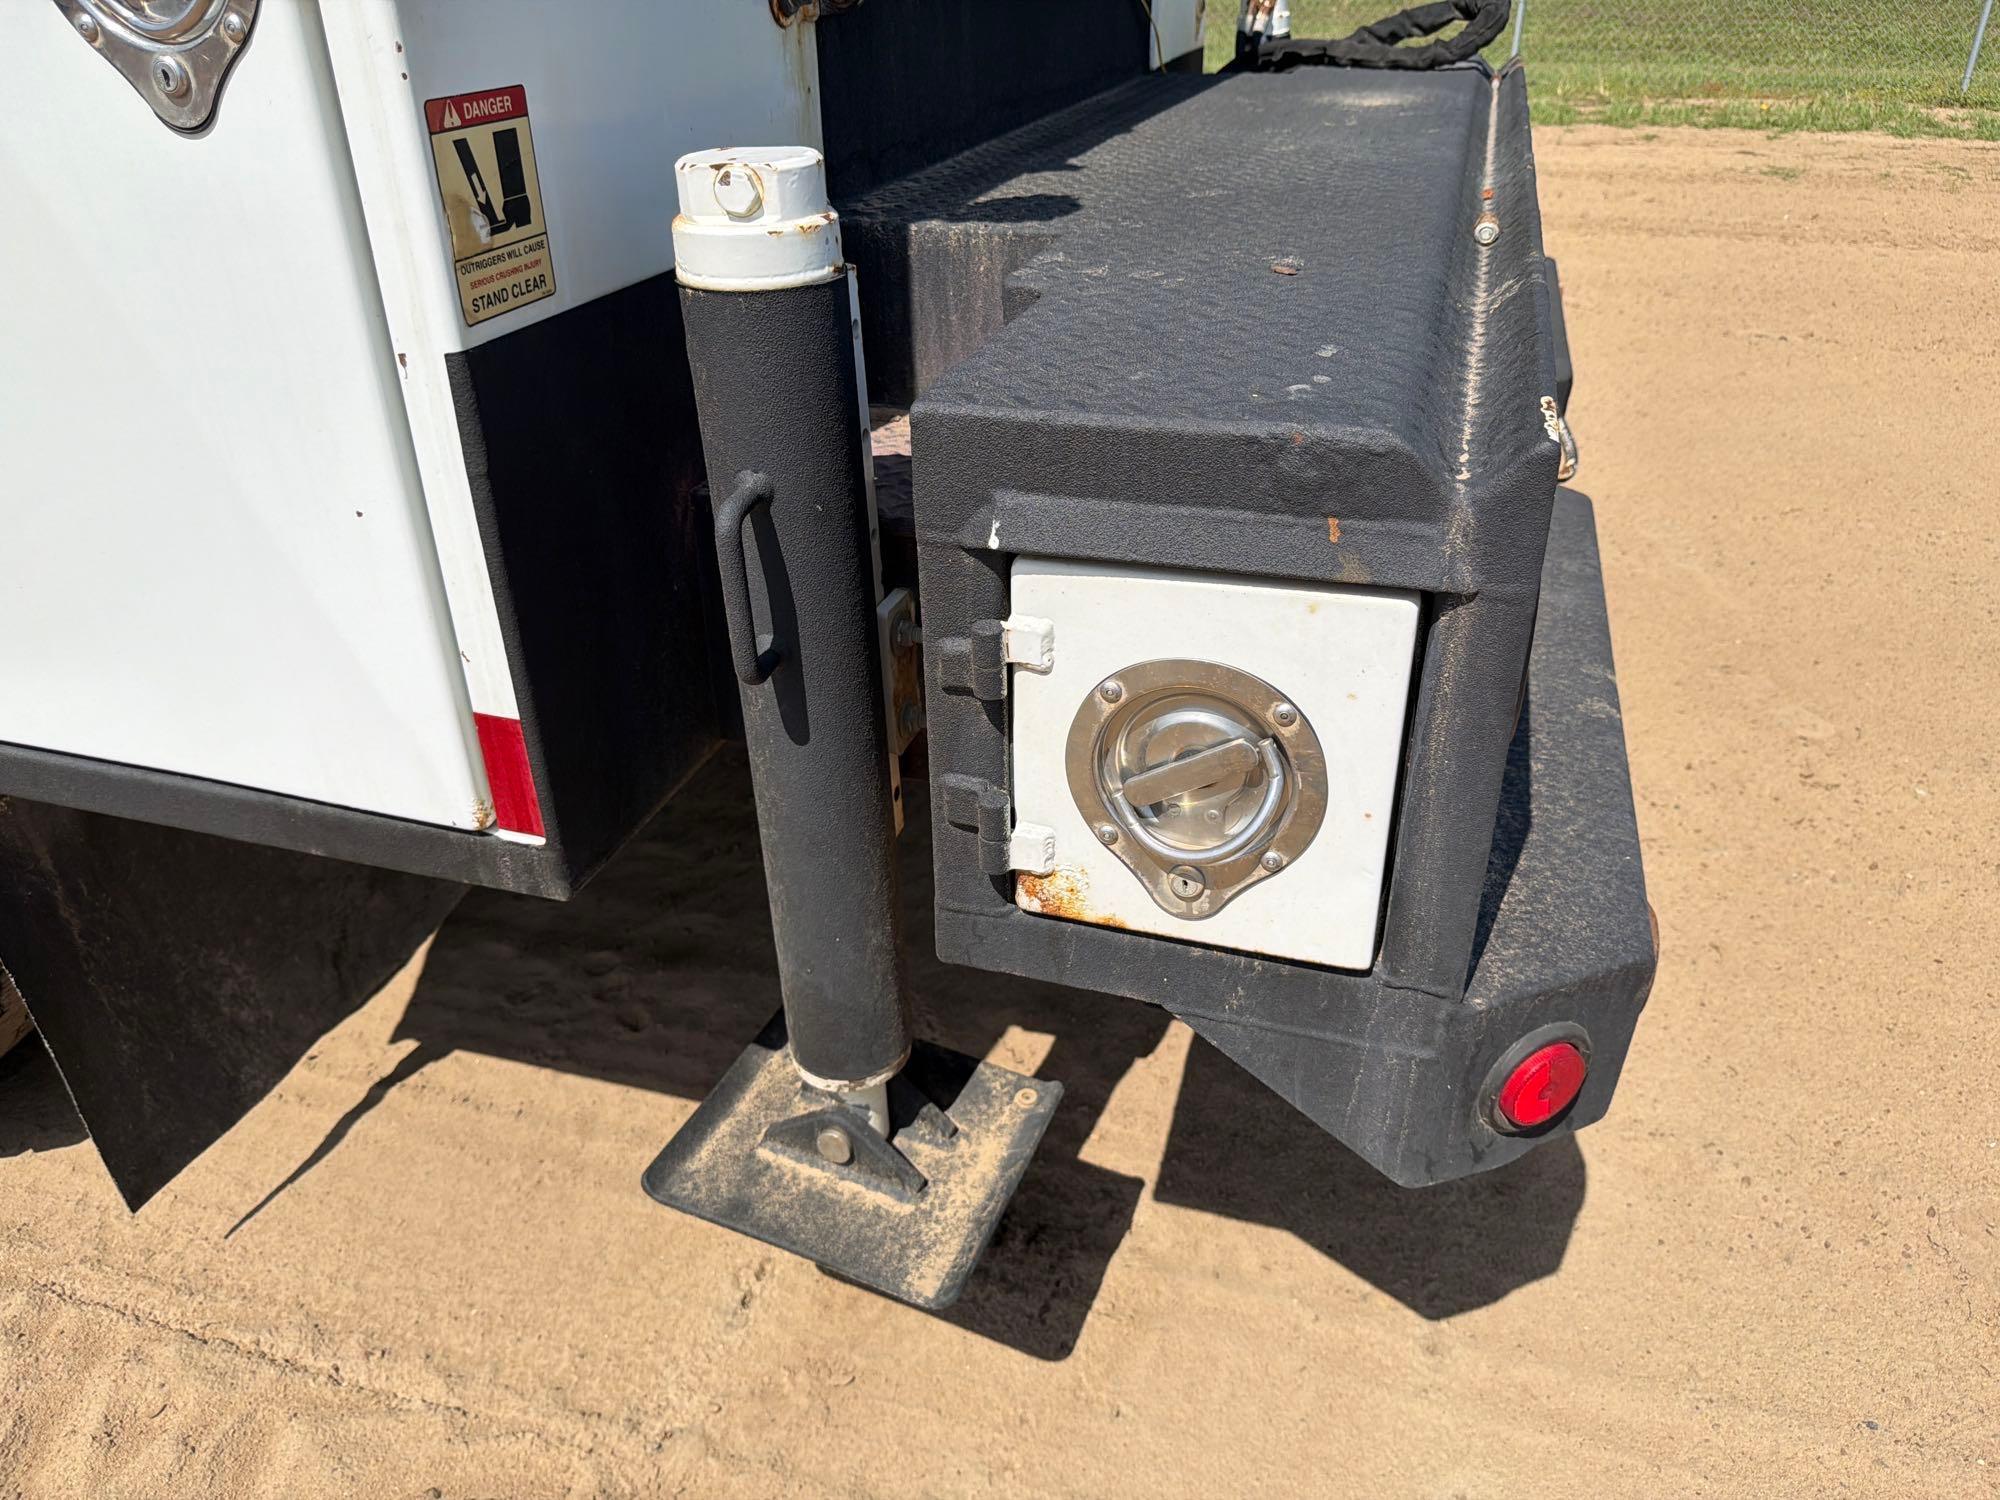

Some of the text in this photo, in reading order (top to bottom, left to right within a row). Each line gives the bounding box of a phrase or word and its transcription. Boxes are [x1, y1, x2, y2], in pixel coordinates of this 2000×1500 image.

[463, 95, 512, 119] DANGER
[460, 240, 545, 275] OUTRIGGERS WILL CAUSE
[470, 259, 542, 290] SERIOUS CRUSHING INJURY
[472, 274, 547, 313] STAND CLEAR
